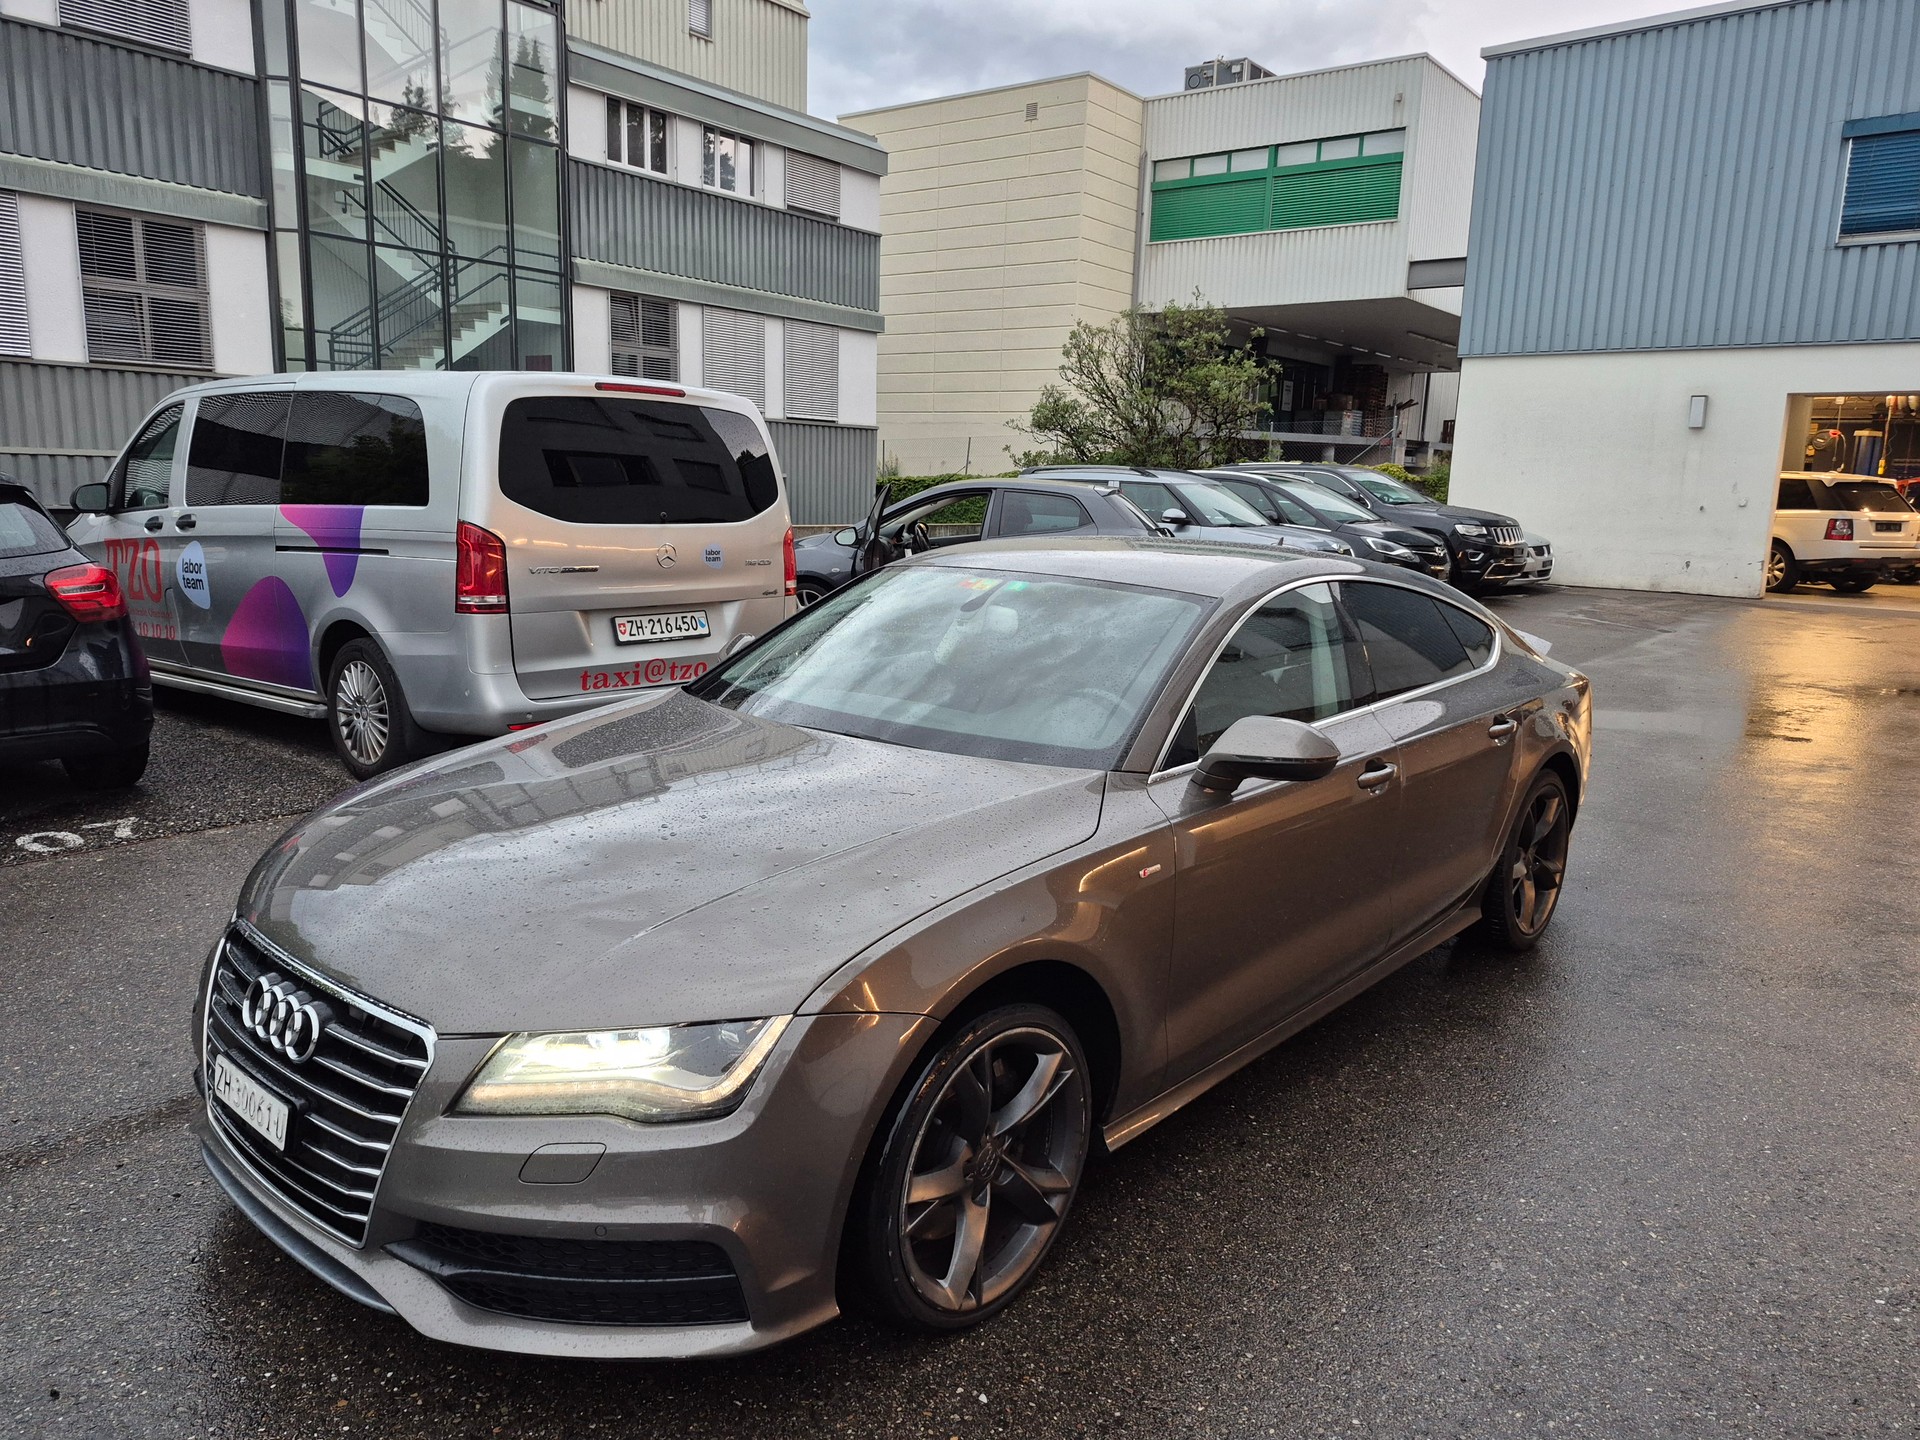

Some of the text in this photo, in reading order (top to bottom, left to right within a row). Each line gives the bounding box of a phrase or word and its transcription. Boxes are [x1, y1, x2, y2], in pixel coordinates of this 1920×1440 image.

[104, 537, 163, 603] TZO
[182, 558, 203, 575] labor
[182, 574, 205, 591] team
[152, 624, 162, 639] 10
[165, 626, 177, 641] 10
